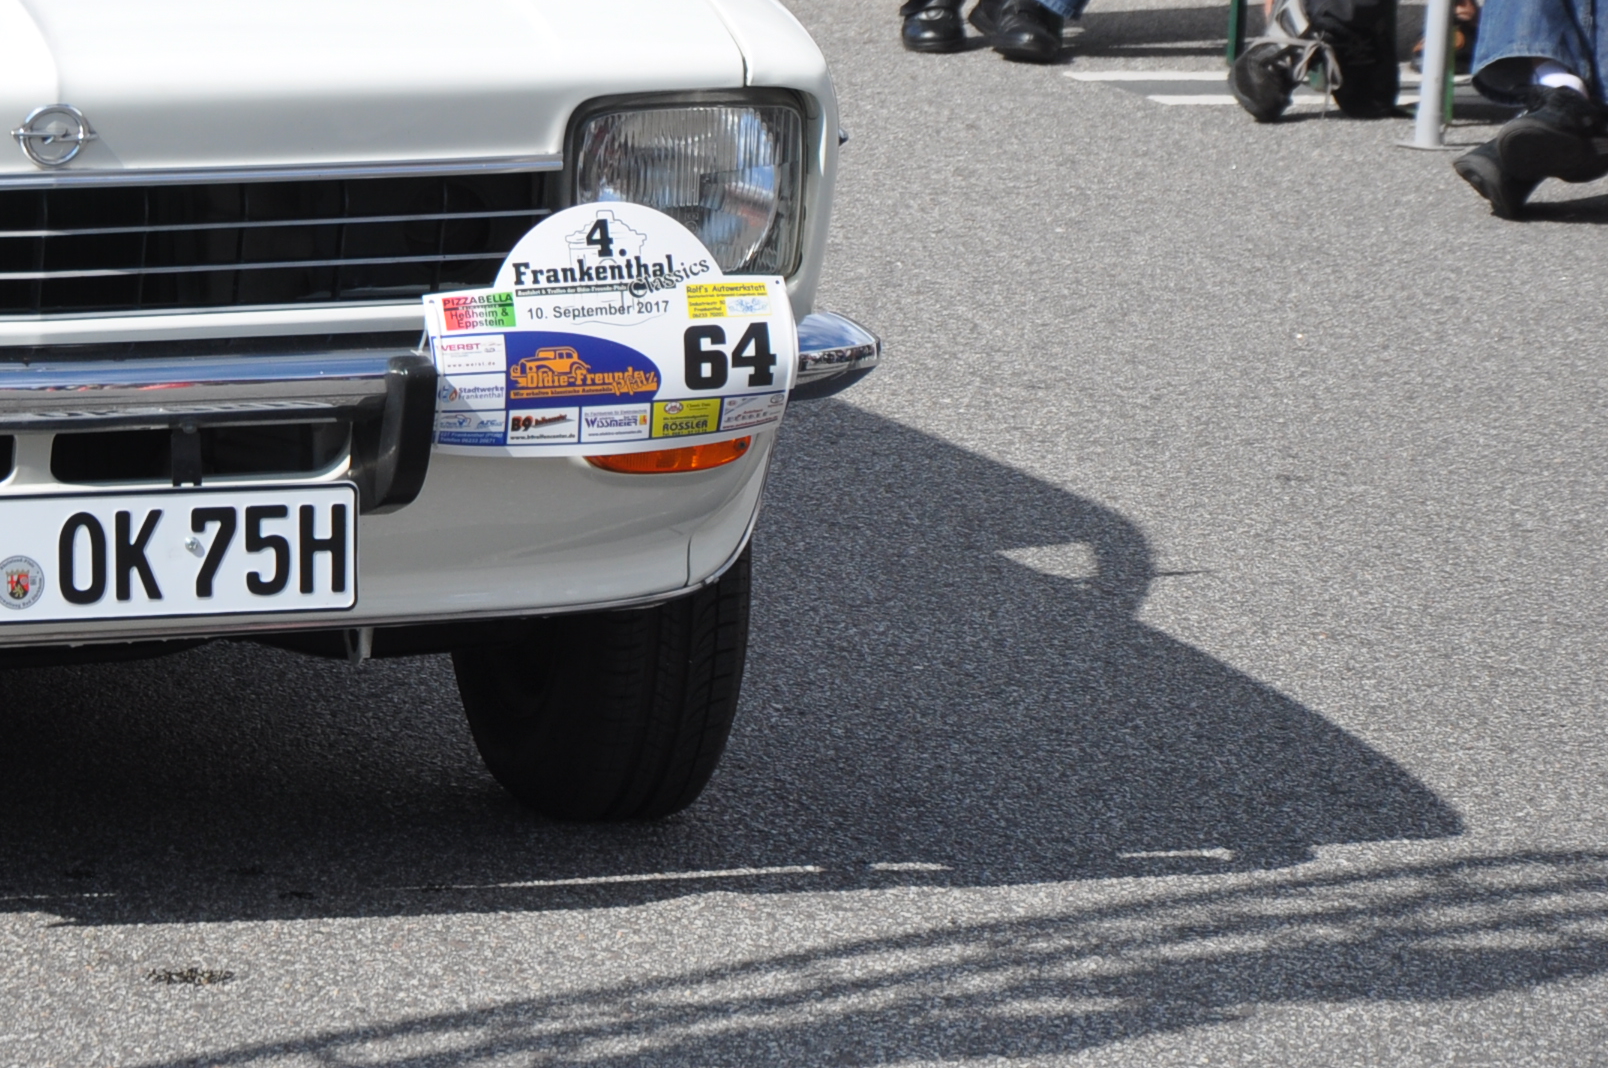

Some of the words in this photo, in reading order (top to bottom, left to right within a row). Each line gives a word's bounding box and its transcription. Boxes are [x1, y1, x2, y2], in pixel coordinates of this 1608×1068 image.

[586, 218, 627, 258] 4.
[512, 254, 675, 286] Frankenthal
[628, 258, 710, 299] Classics
[443, 293, 513, 307] PIZZABELLA
[449, 308, 498, 320] Heßheim
[500, 307, 509, 317] &
[527, 307, 548, 320] 10.
[553, 303, 633, 320] September
[637, 300, 670, 314] 2017
[457, 317, 505, 329] Eppstein
[683, 321, 777, 391] 64
[526, 366, 644, 388] Oldie-Freunde
[458, 385, 505, 394] Stadtwerke
[458, 392, 504, 400] Frankenthal
[511, 415, 534, 432] B9
[662, 419, 709, 432] RÖSSLER
[58, 508, 164, 606] OK
[191, 504, 347, 599] 75H
